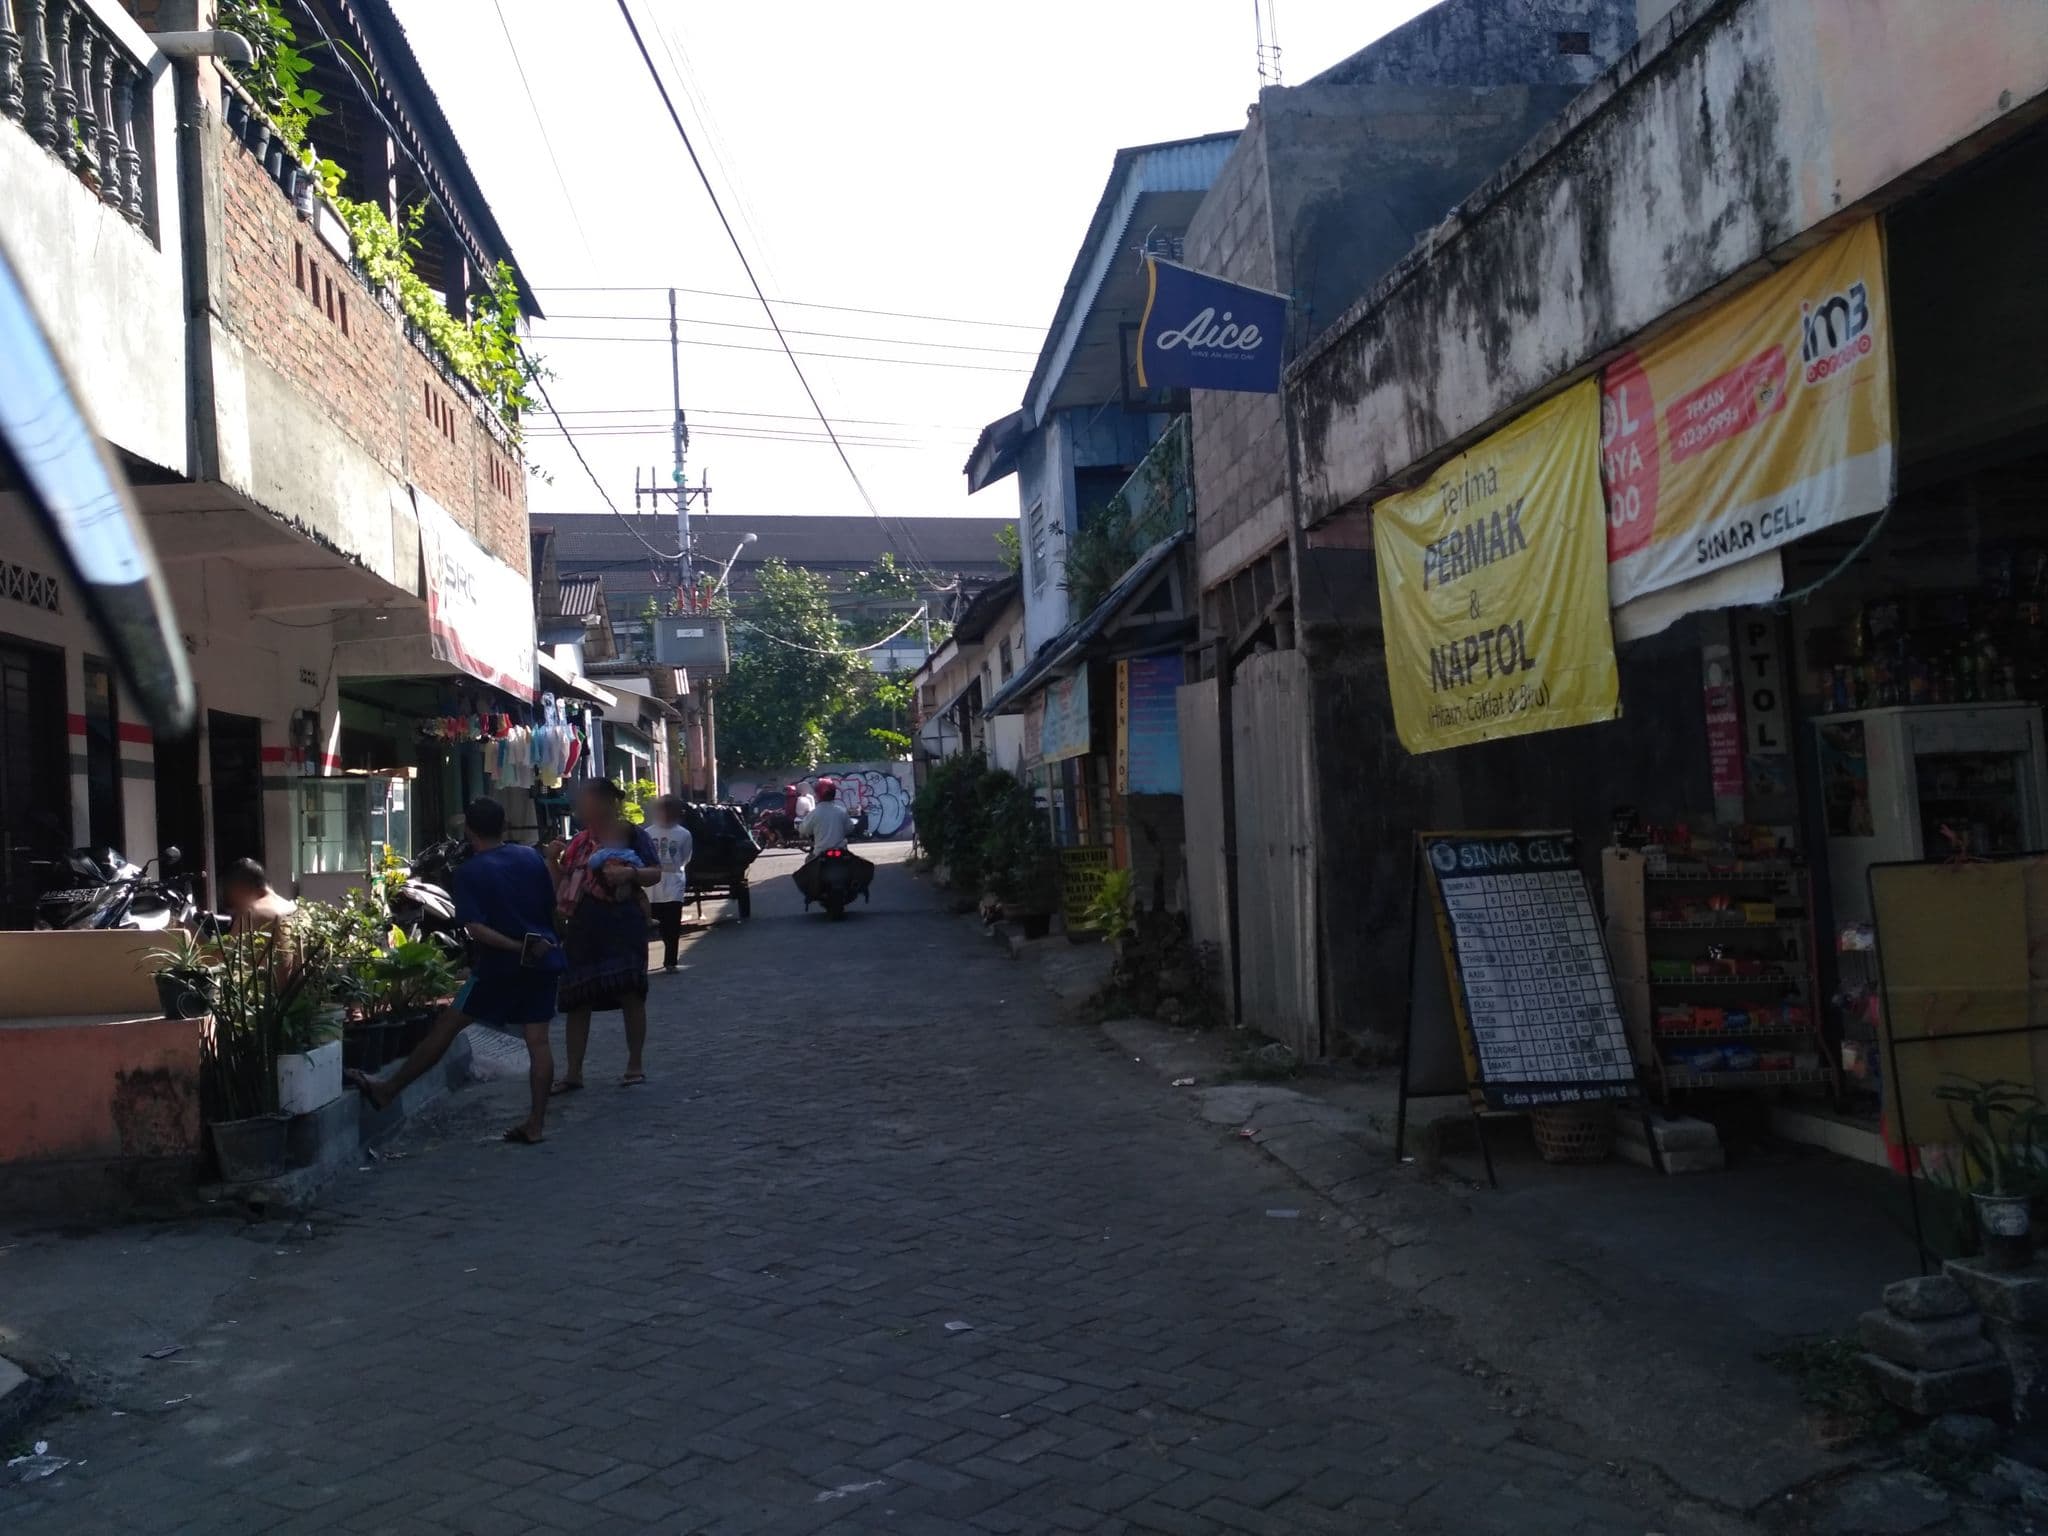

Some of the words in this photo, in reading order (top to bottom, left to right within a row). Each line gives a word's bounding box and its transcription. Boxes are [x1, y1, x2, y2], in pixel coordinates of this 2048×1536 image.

[1157, 307, 1262, 350] Aice
[1439, 466, 1499, 519] Terima
[1423, 497, 1528, 592] PERMAK
[1697, 521, 1755, 564] SINAR
[1759, 498, 1807, 540] CELL
[1469, 590, 1481, 620] &
[1430, 619, 1536, 693] NAPTOL
[1460, 840, 1520, 868] SINAR
[1527, 838, 1571, 865] CELL
